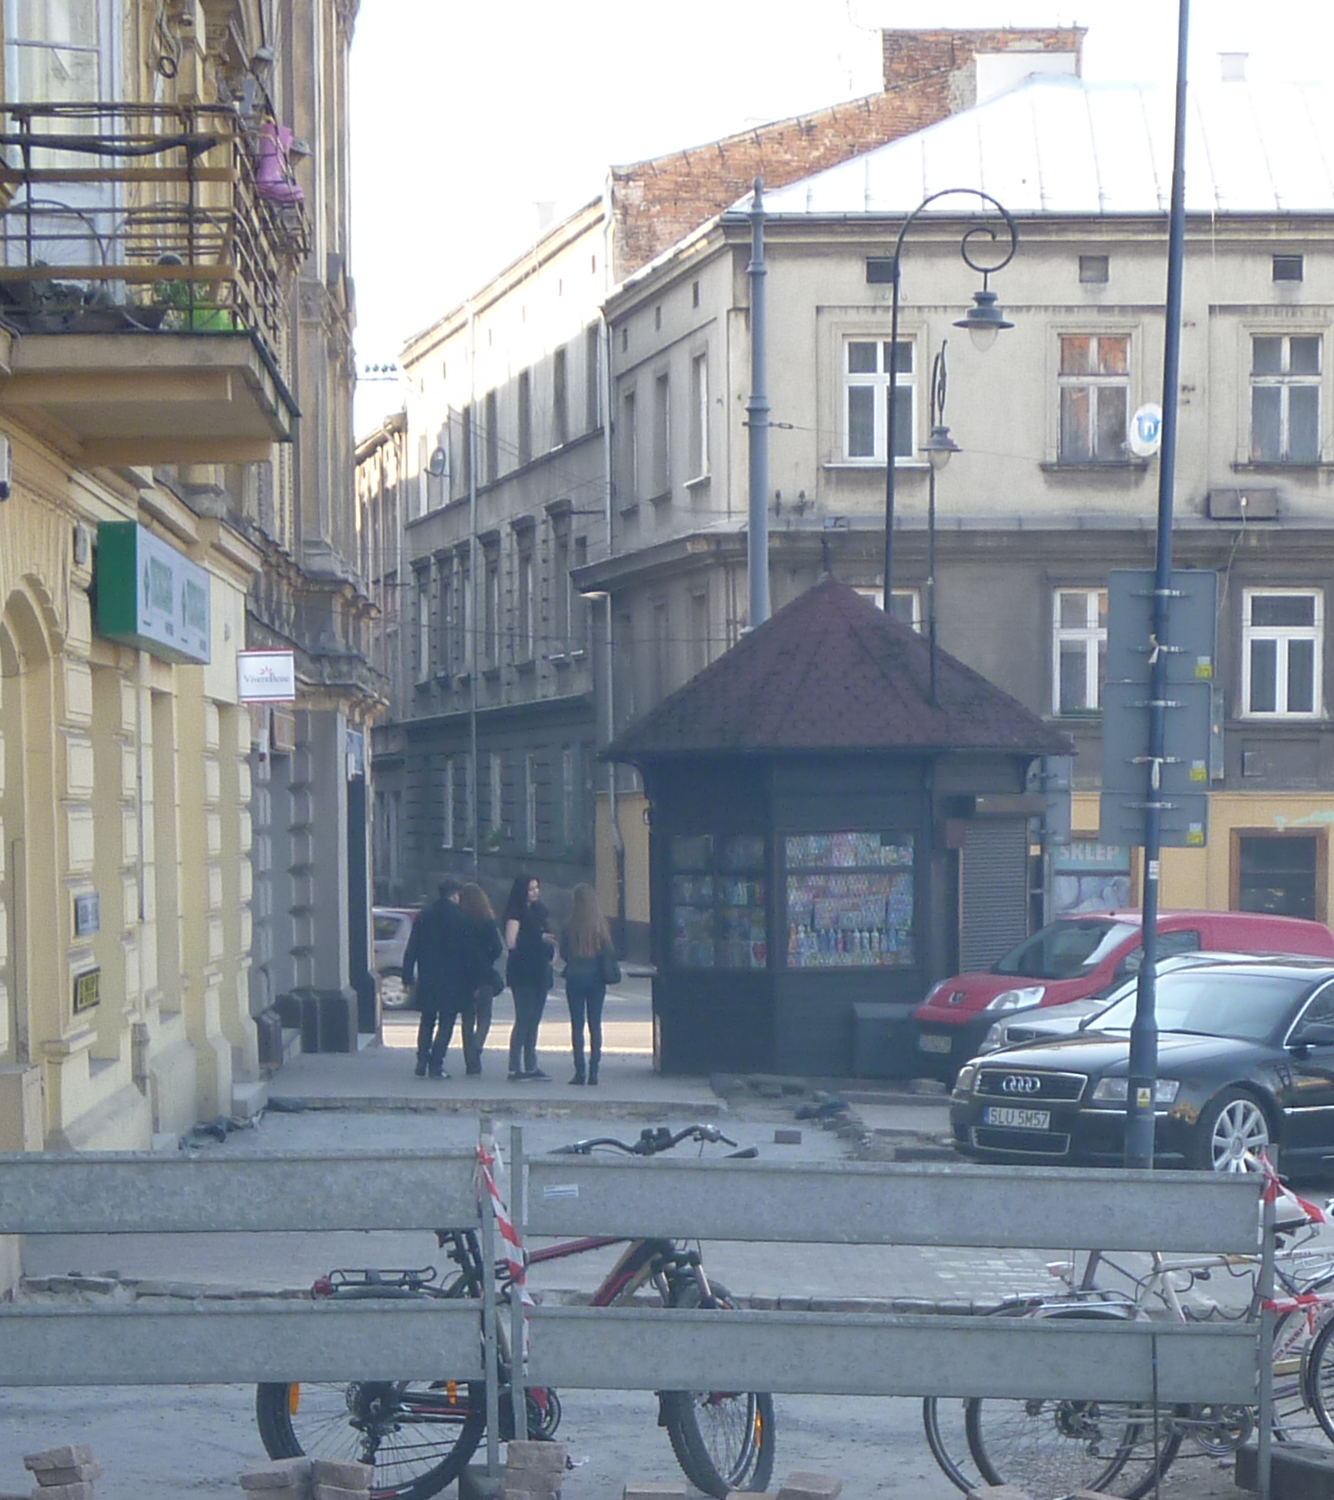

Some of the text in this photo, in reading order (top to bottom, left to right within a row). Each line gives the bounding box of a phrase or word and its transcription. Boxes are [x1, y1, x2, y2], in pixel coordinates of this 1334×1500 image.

[1060, 844, 1120, 861] SKLEP
[990, 1108, 1049, 1130] SLU 5M57
